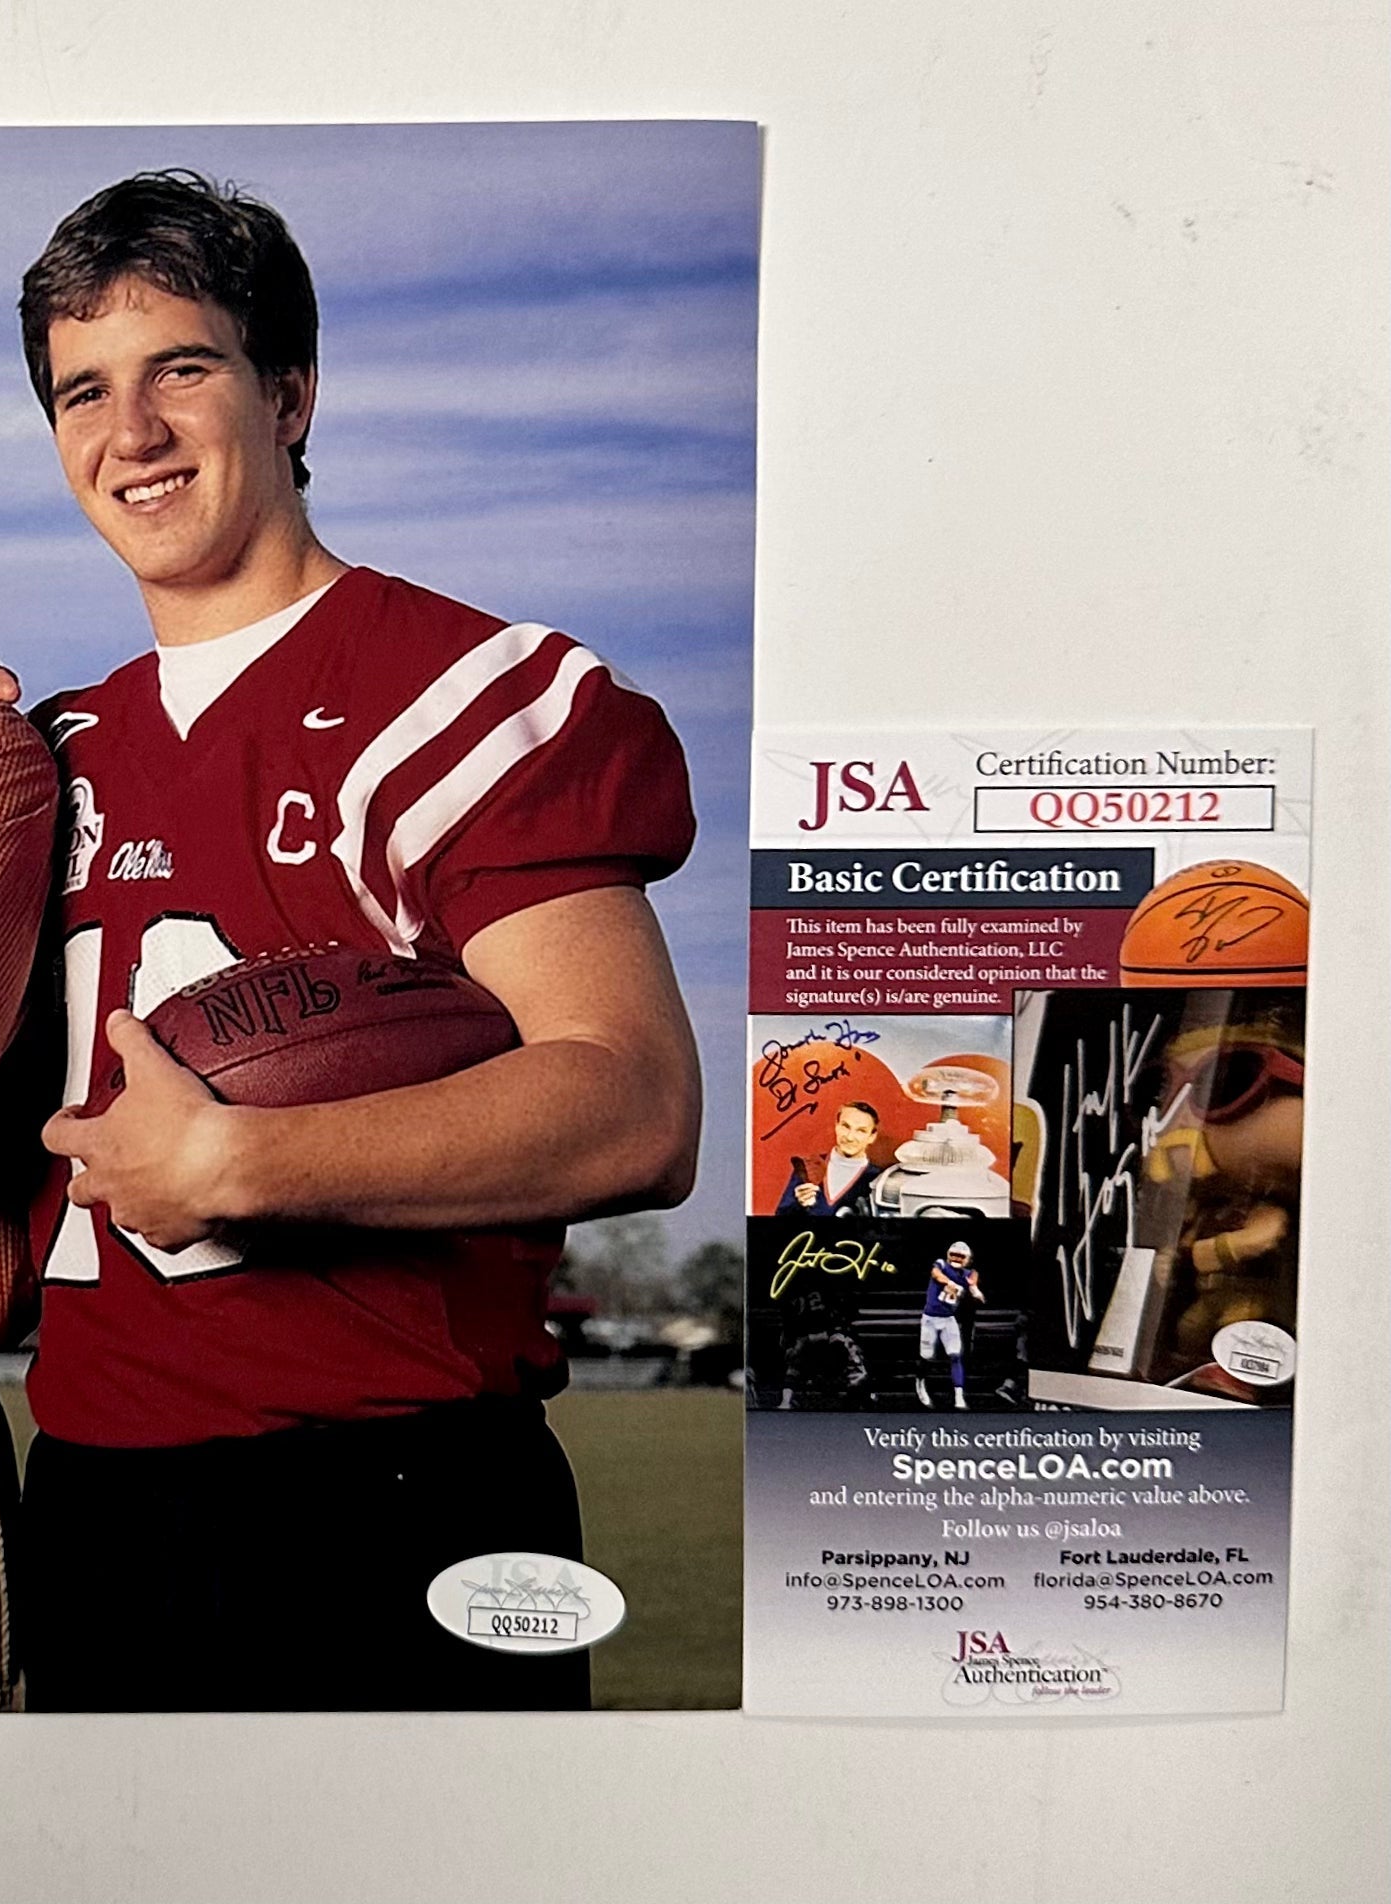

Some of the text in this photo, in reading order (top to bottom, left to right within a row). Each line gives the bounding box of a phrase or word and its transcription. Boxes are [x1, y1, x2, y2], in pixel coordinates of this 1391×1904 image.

[976, 751, 1276, 777] Certification Number:
[799, 761, 929, 831] JSA
[1030, 791, 1220, 827] QQ50212
[266, 789, 317, 866] C
[788, 861, 1121, 893] Basic Certification
[787, 918, 1083, 937] This item has been fully examined by
[787, 942, 1063, 959] James Spence Authentication, LLC
[786, 965, 1106, 983] and it is our considered opinion that the
[195, 961, 342, 1046] NFL
[786, 989, 1001, 1007] signature(s) is/are genuine.
[864, 1427, 1201, 1451] Verify this certification by visiting
[892, 1454, 1172, 1484] SpenceLOA.com
[810, 1485, 1250, 1512] and entering the alpha-numeric value above.
[942, 1519, 1121, 1542] Follow us @jsaloa
[821, 1550, 970, 1569] Parsippany, NJ
[1060, 1548, 1248, 1565] Fort Lauderdale, FL
[785, 1572, 1005, 1591] info@SpenceLOA.com
[1034, 1570, 1273, 1589] florida@SpenceLOA.com
[827, 1595, 963, 1611] 973-898-1300
[1084, 1594, 1223, 1610] 954-380-8670
[491, 1613, 559, 1636] QQ50212
[952, 1630, 1011, 1663] JSA
